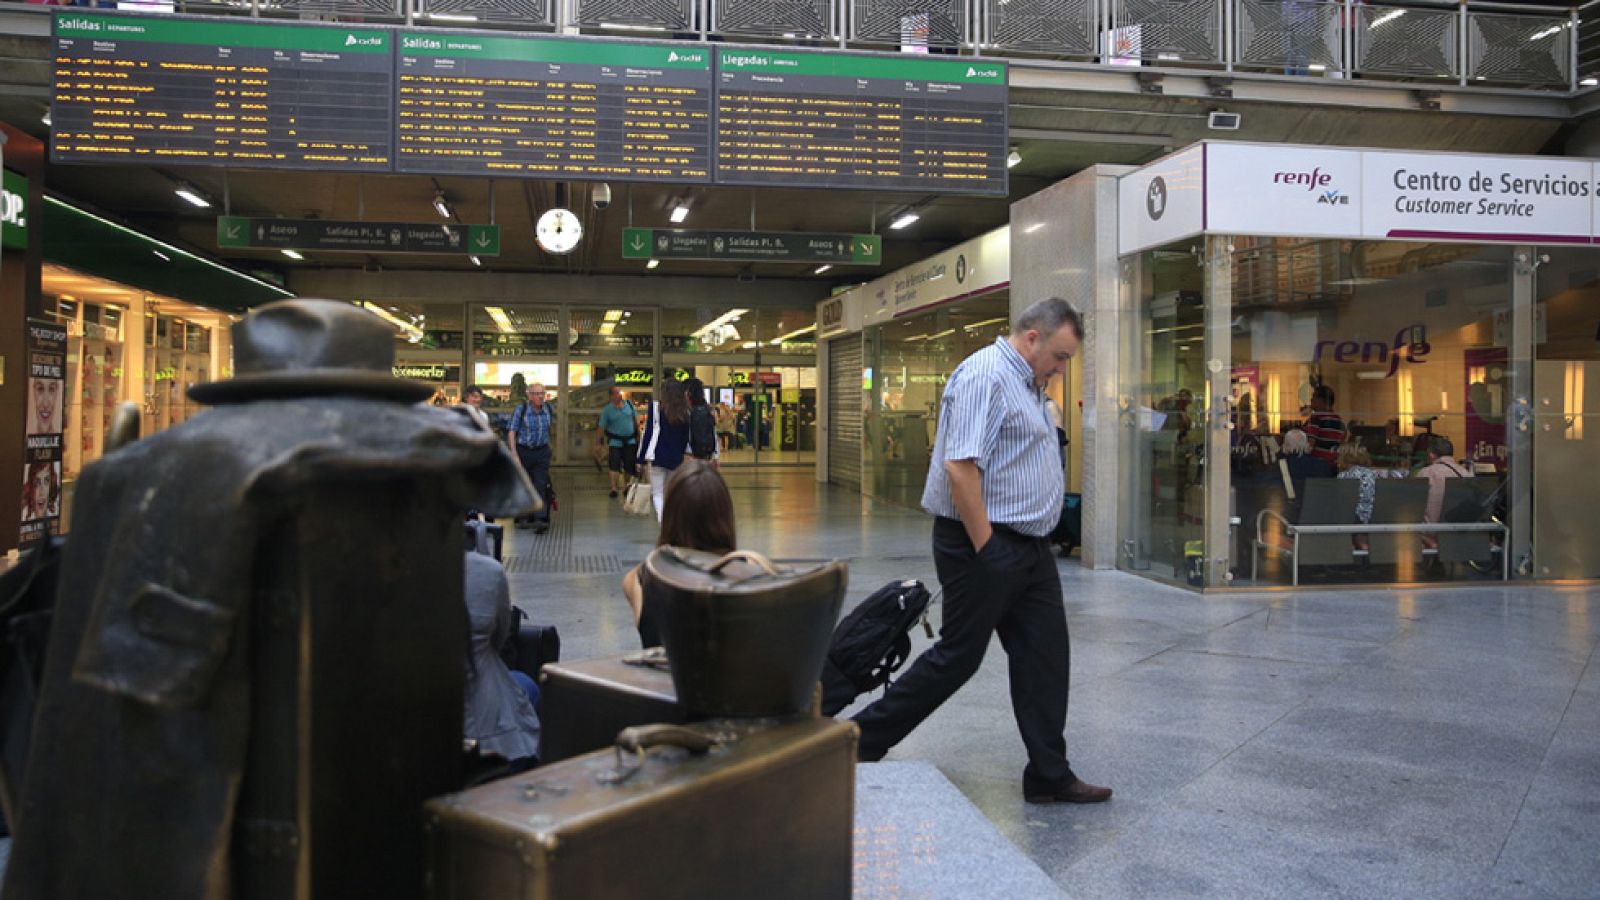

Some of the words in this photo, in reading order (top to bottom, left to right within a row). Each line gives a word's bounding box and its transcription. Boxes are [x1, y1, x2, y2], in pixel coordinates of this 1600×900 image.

[59, 18, 100, 31] Salidas
[107, 24, 145, 33] DEPARTURES
[403, 37, 441, 49] Salidas
[447, 43, 482, 51] DEPARTURES
[723, 55, 768, 67] Llegadas
[1273, 167, 1332, 191] renfe
[1393, 169, 1461, 192] Centro
[1469, 170, 1493, 192] de
[1501, 173, 1589, 196] Servicios
[1317, 192, 1349, 206] AVE
[1395, 195, 1473, 215] Customer
[1477, 198, 1534, 216] Service
[271, 225, 297, 234] Aseos
[326, 226, 359, 236] Salidas
[408, 230, 443, 240] Llegadas
[673, 237, 707, 246] Llegadas
[729, 237, 759, 247] Salidas
[809, 239, 833, 249] Aseos
[1313, 327, 1431, 378] renfe
